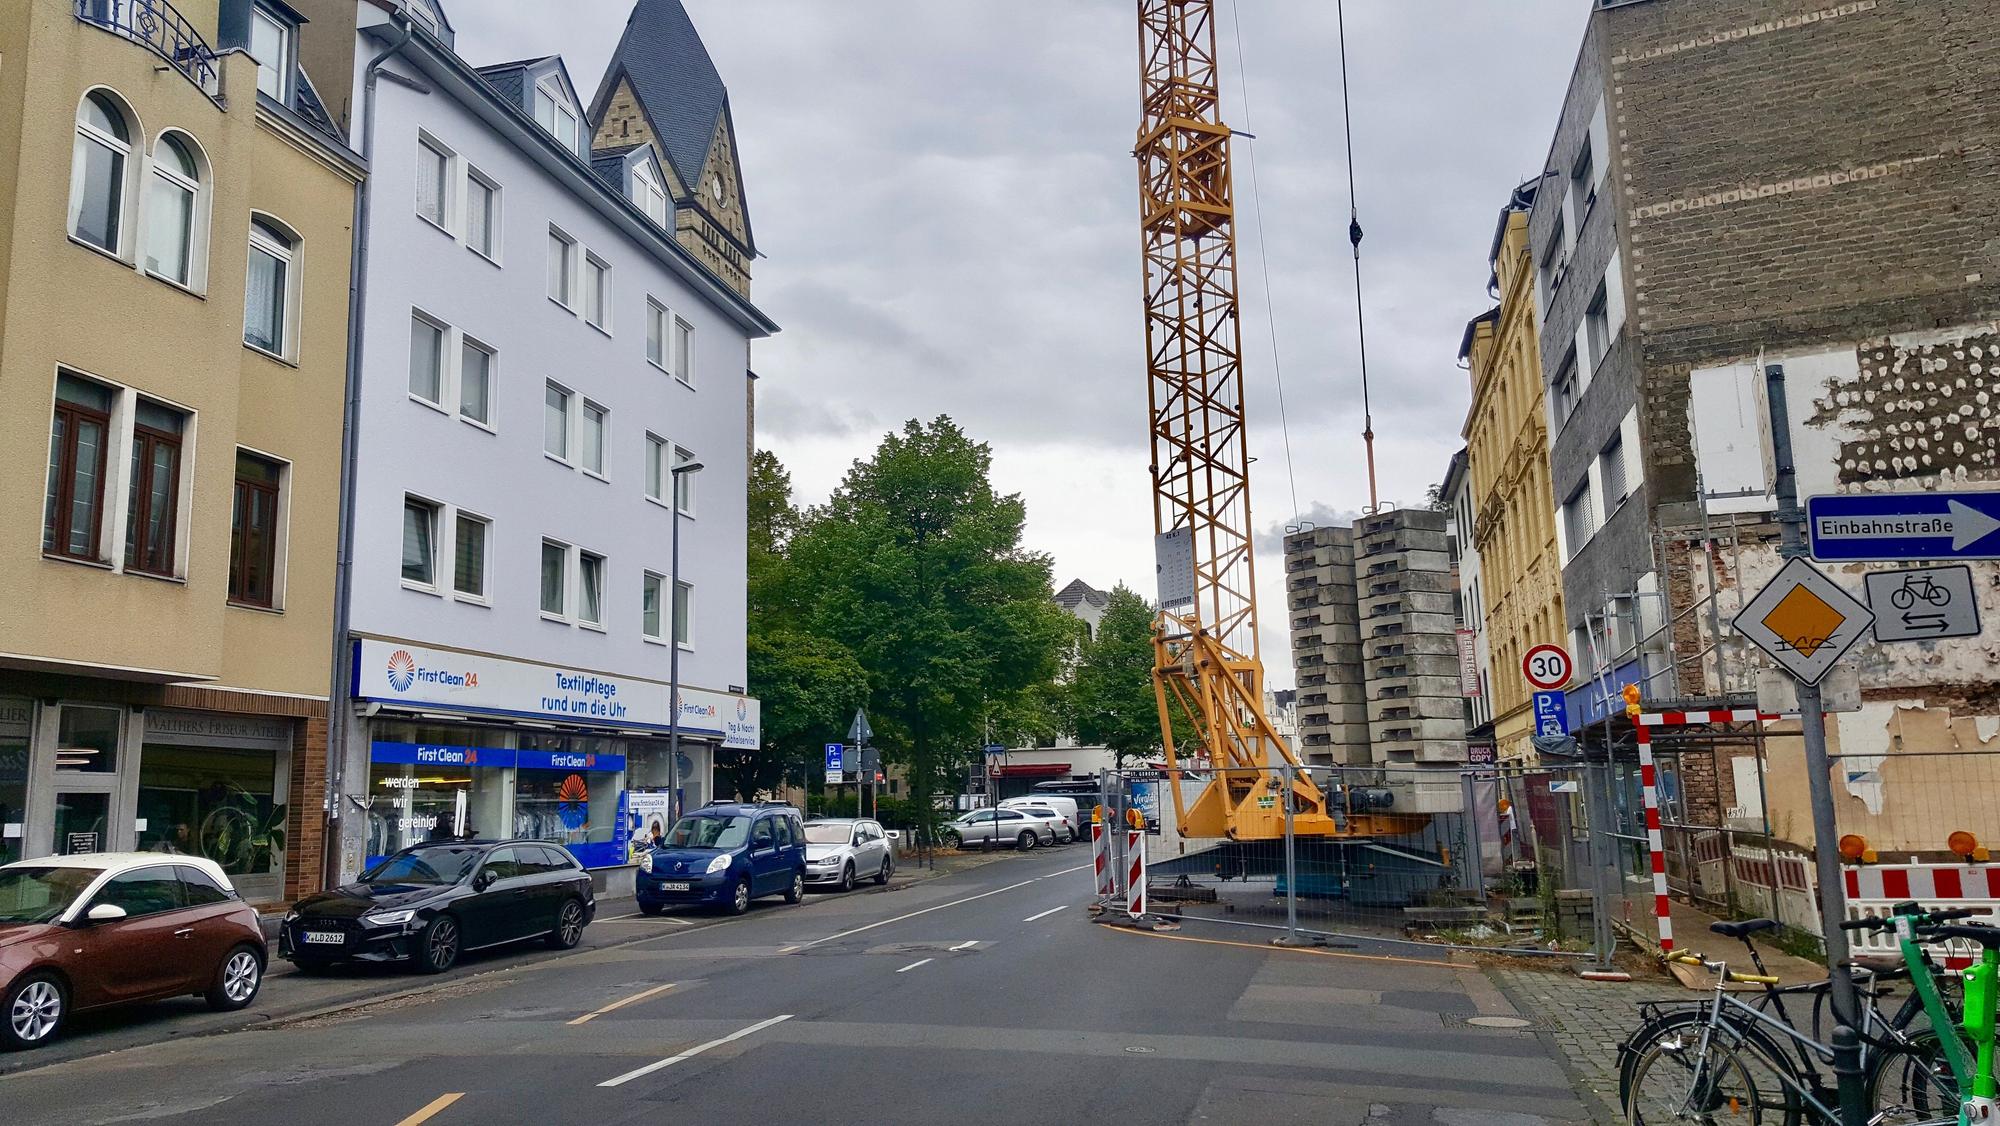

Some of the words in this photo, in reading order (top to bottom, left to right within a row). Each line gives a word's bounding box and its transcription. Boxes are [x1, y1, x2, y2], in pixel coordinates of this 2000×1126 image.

[1822, 518, 1953, 535] Einbahnstraße
[1161, 596, 1192, 609] LIEBHERR
[1533, 656, 1561, 677] 30
[417, 668, 439, 683] First
[439, 669, 464, 686] Clean
[464, 671, 478, 687] 24
[555, 673, 616, 698] Textilpflege
[542, 697, 567, 712] rund
[571, 700, 588, 713] um
[591, 698, 606, 716] die
[609, 701, 626, 718] Uhr
[683, 703, 694, 714] First
[694, 704, 708, 716] Clean
[707, 705, 715, 717] 24
[417, 748, 437, 762] First
[437, 749, 463, 763] Clean
[464, 750, 478, 764] 24
[552, 754, 566, 767] First
[566, 755, 586, 767] Clean
[585, 755, 595, 767] 24
[385, 776, 419, 788] werden
[393, 795, 408, 808] wir
[398, 815, 438, 831] gereinigt
[406, 835, 423, 847] und
[314, 933, 325, 942] LD
[325, 934, 343, 943] 2612
